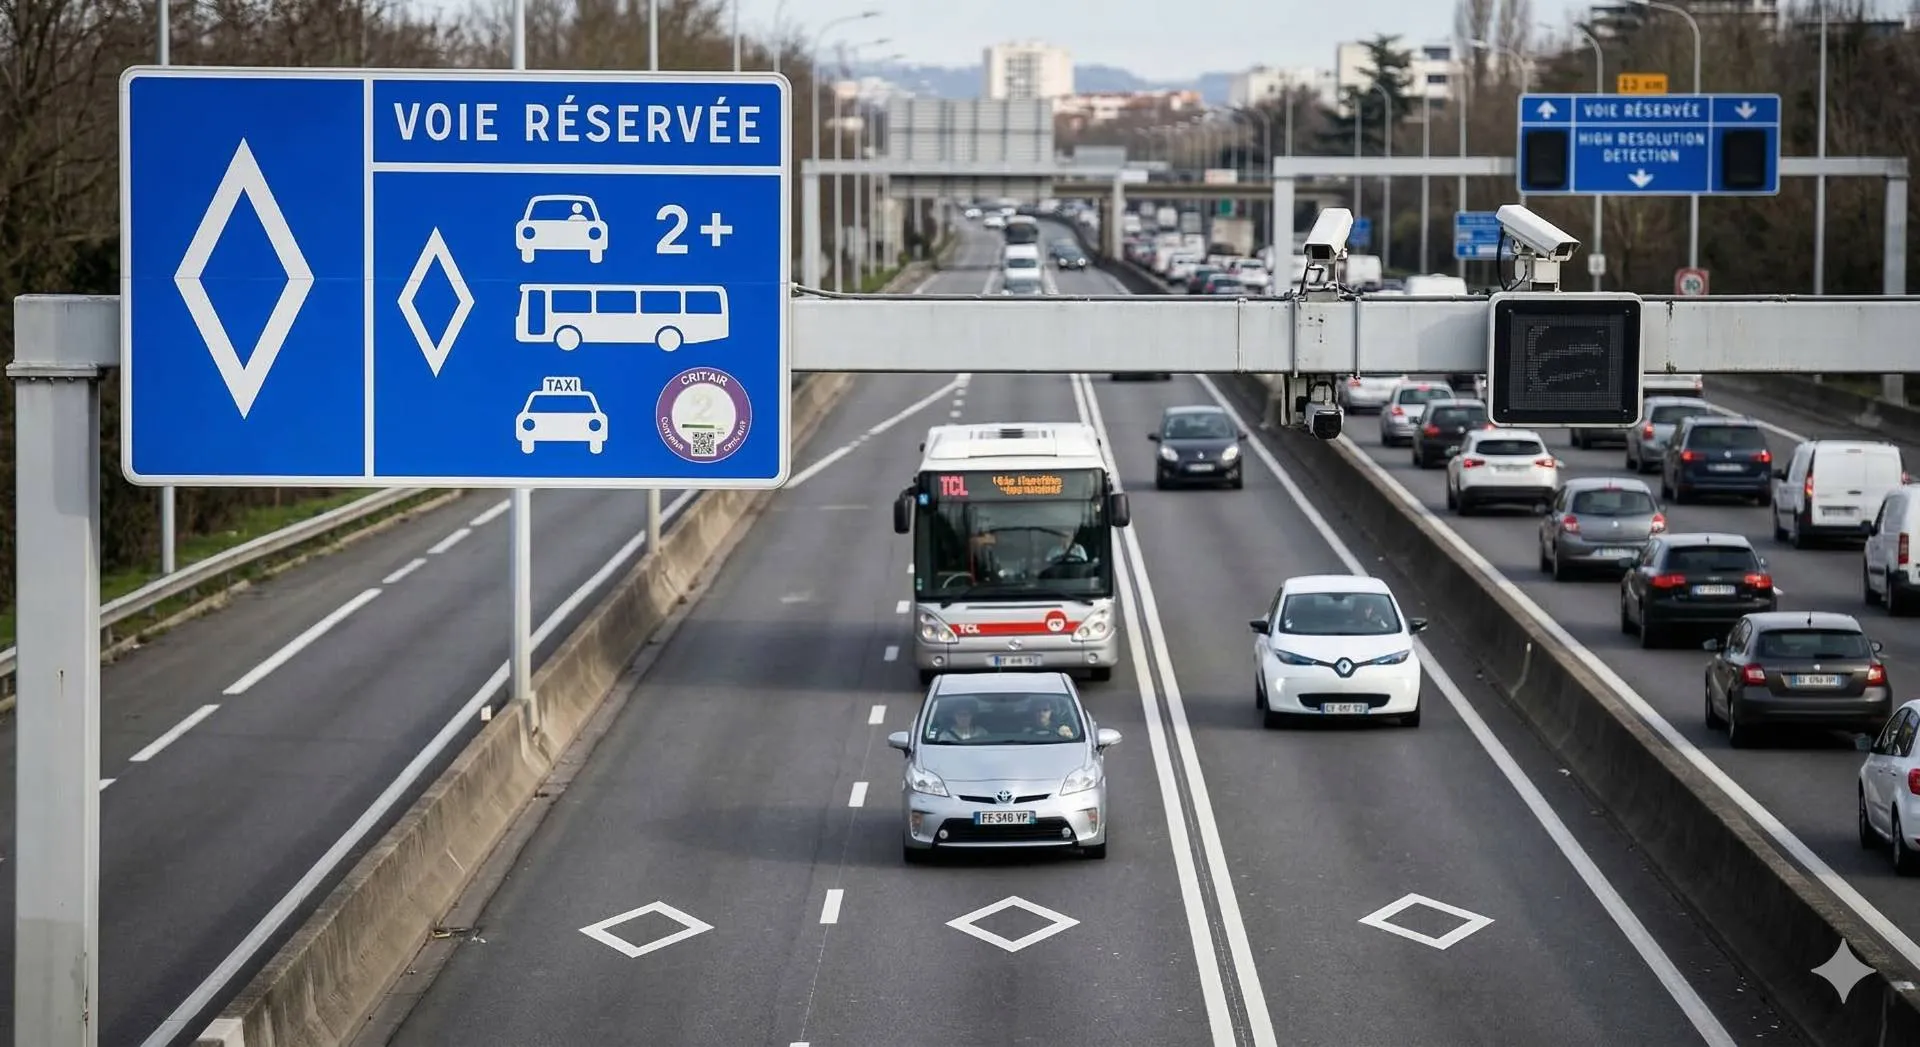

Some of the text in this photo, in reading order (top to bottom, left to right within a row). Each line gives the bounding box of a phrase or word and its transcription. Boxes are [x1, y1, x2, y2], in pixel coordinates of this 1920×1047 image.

[1583, 101, 1701, 118] VOIE RÉSERVÉE
[394, 95, 761, 144] VOIE RÉSERVÉE
[1618, 131, 1705, 147] RESOLUTION
[1603, 148, 1680, 163] DETECTION
[546, 379, 578, 391] TAXI
[680, 371, 728, 386] CRIT'AIR
[940, 475, 969, 496] TCL
[958, 623, 981, 634] TCL
